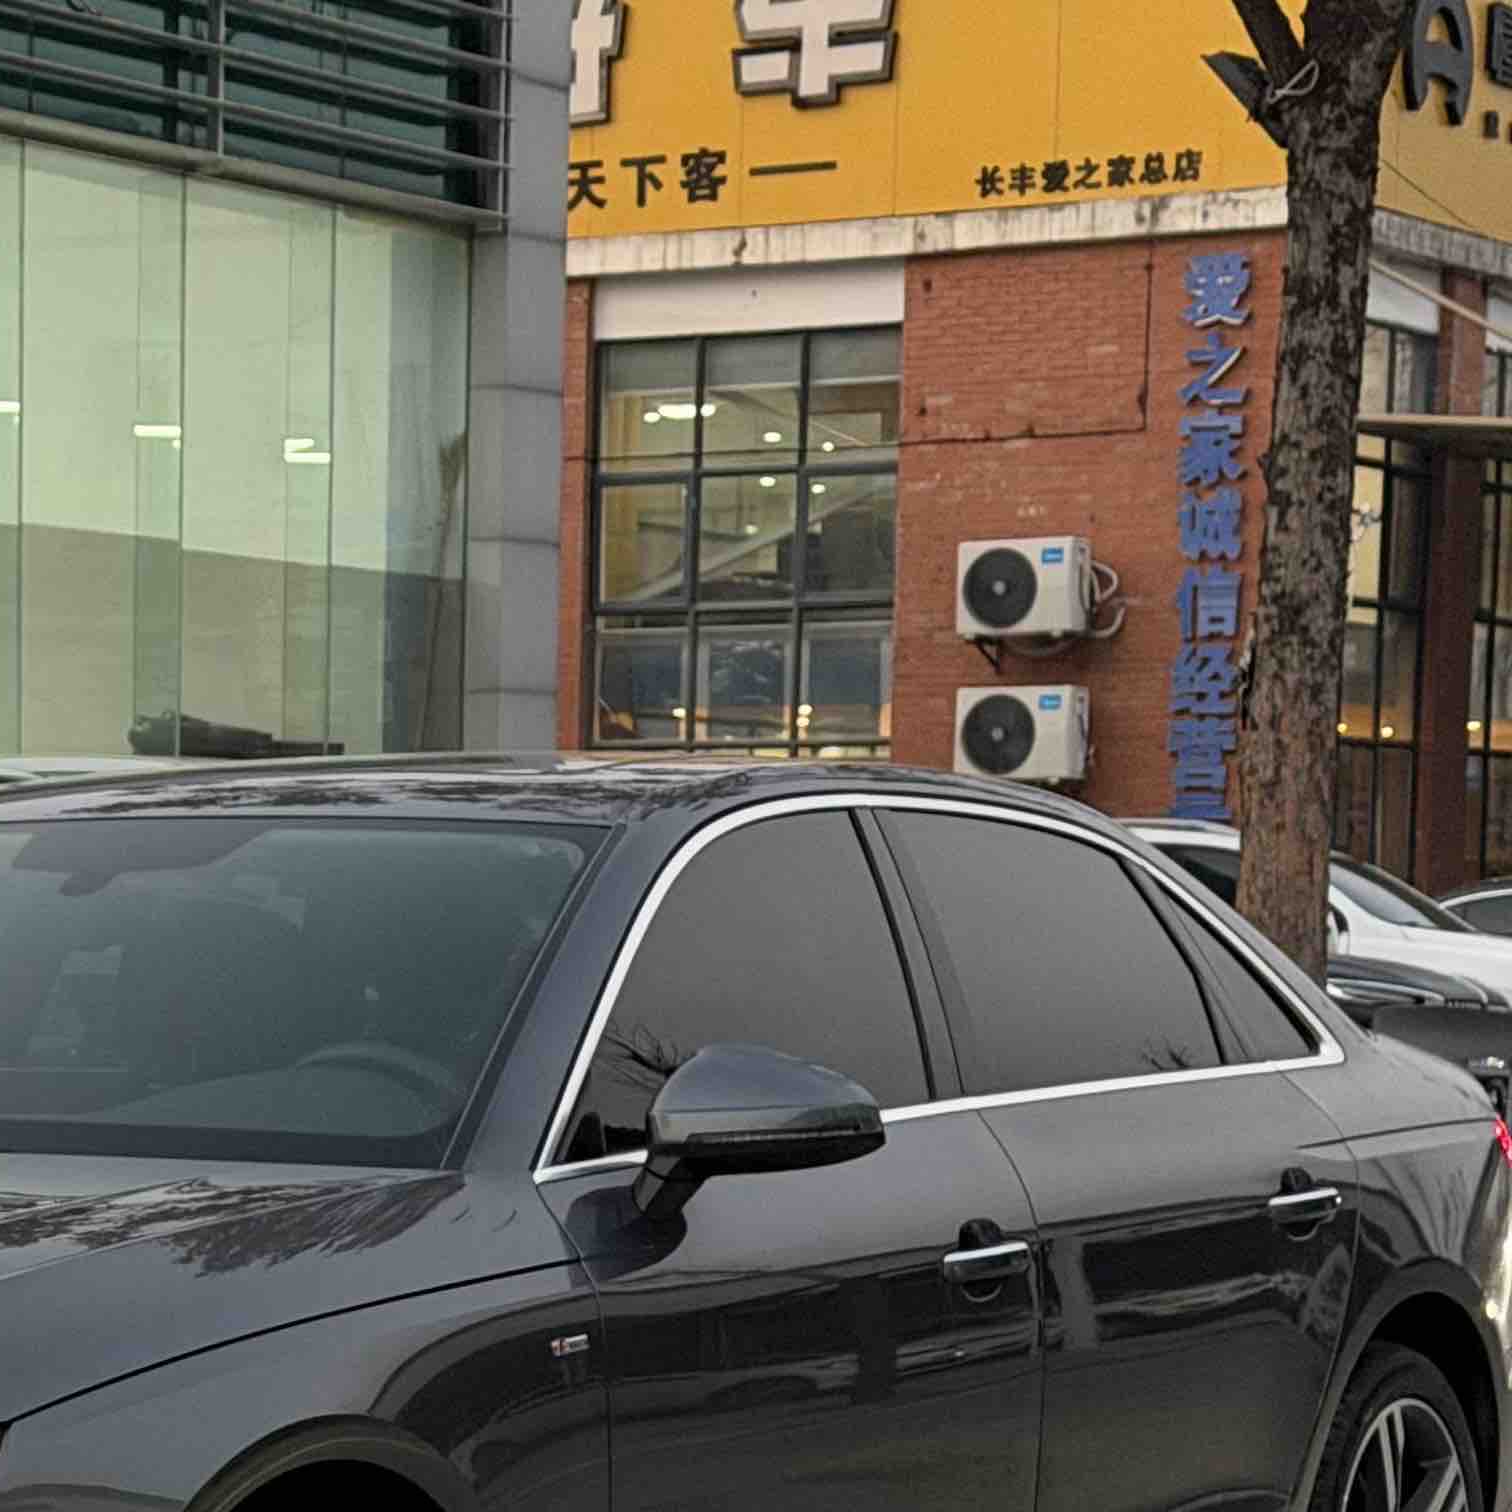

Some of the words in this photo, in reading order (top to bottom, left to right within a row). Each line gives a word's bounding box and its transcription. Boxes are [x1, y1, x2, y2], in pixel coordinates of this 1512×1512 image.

[975, 148, 1203, 198] 长丰爱之家总店
[1169, 254, 1252, 817] 爱之家诚信经营
